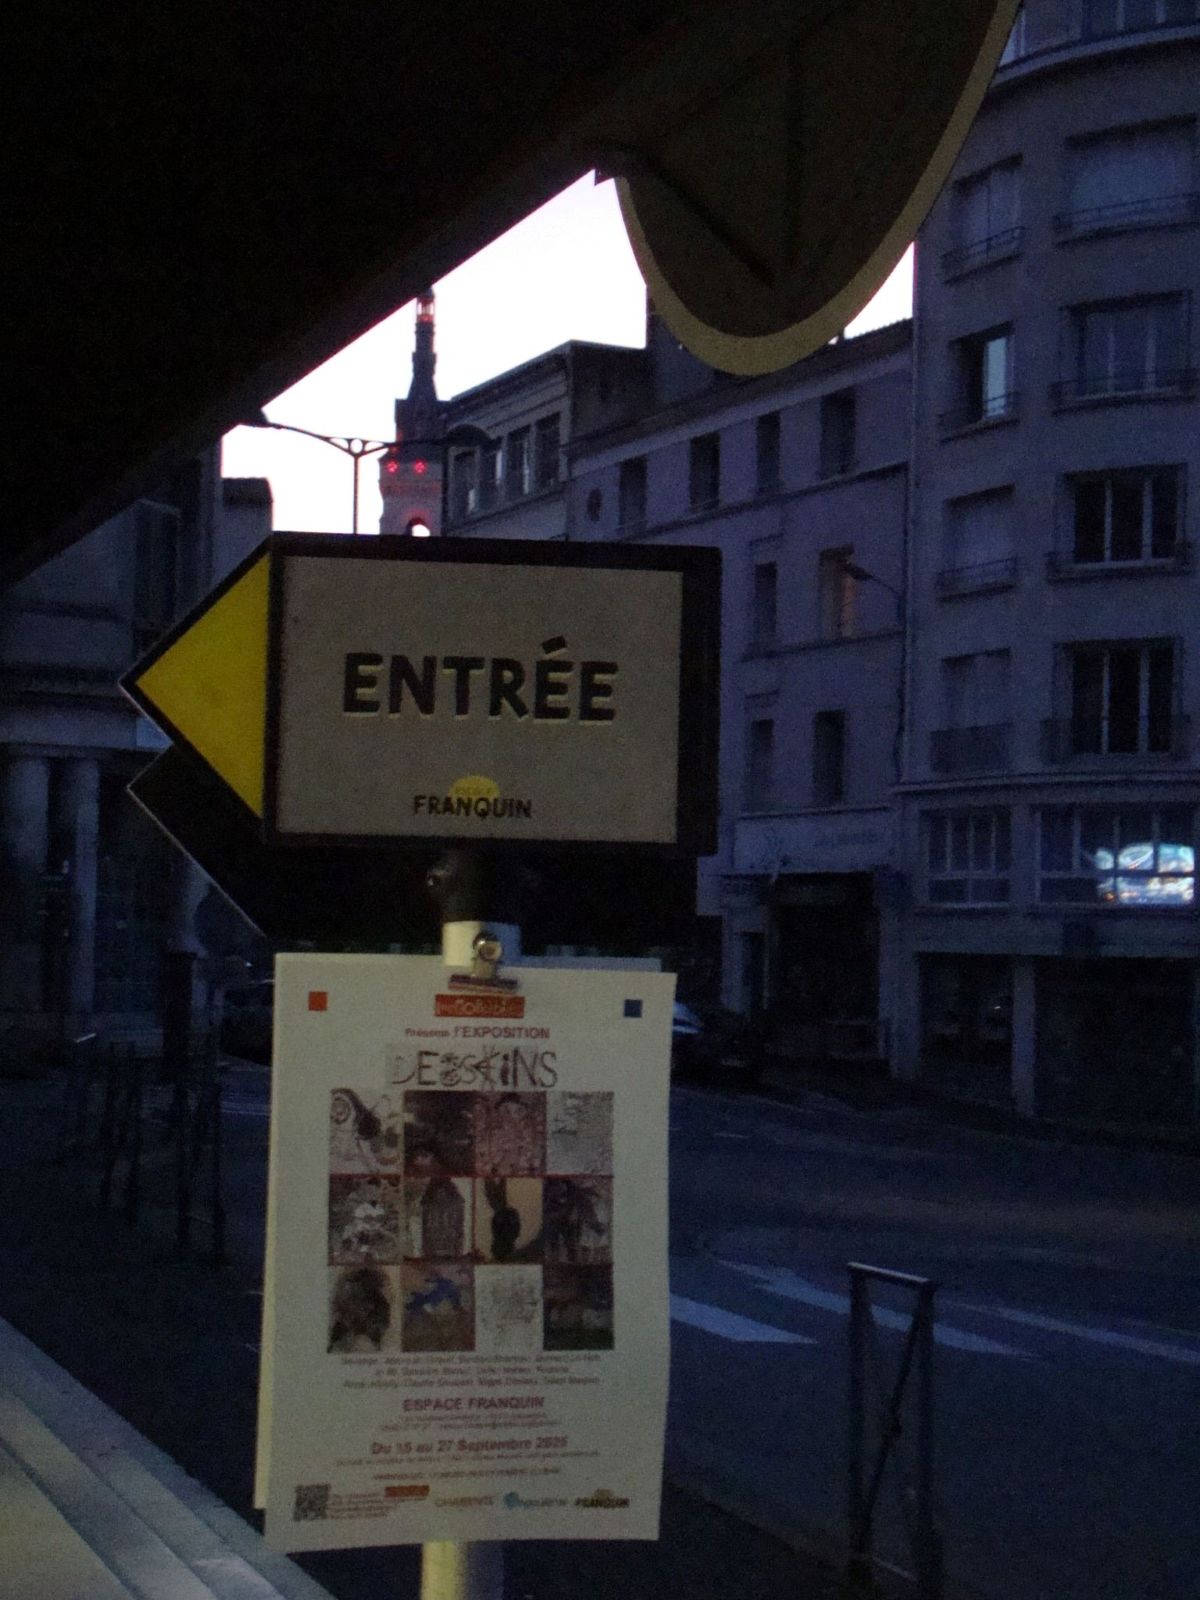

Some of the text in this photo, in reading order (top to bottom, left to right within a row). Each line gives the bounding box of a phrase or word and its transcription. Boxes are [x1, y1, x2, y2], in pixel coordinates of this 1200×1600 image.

[343, 635, 619, 723] ENTRÉE
[414, 795, 532, 820] FRANQUIN
[403, 1396, 545, 1411] ESPACE FRANQUIN
[371, 1441, 391, 1454] Du
[416, 1442, 433, 1453] au
[457, 1438, 532, 1452] Septembre
